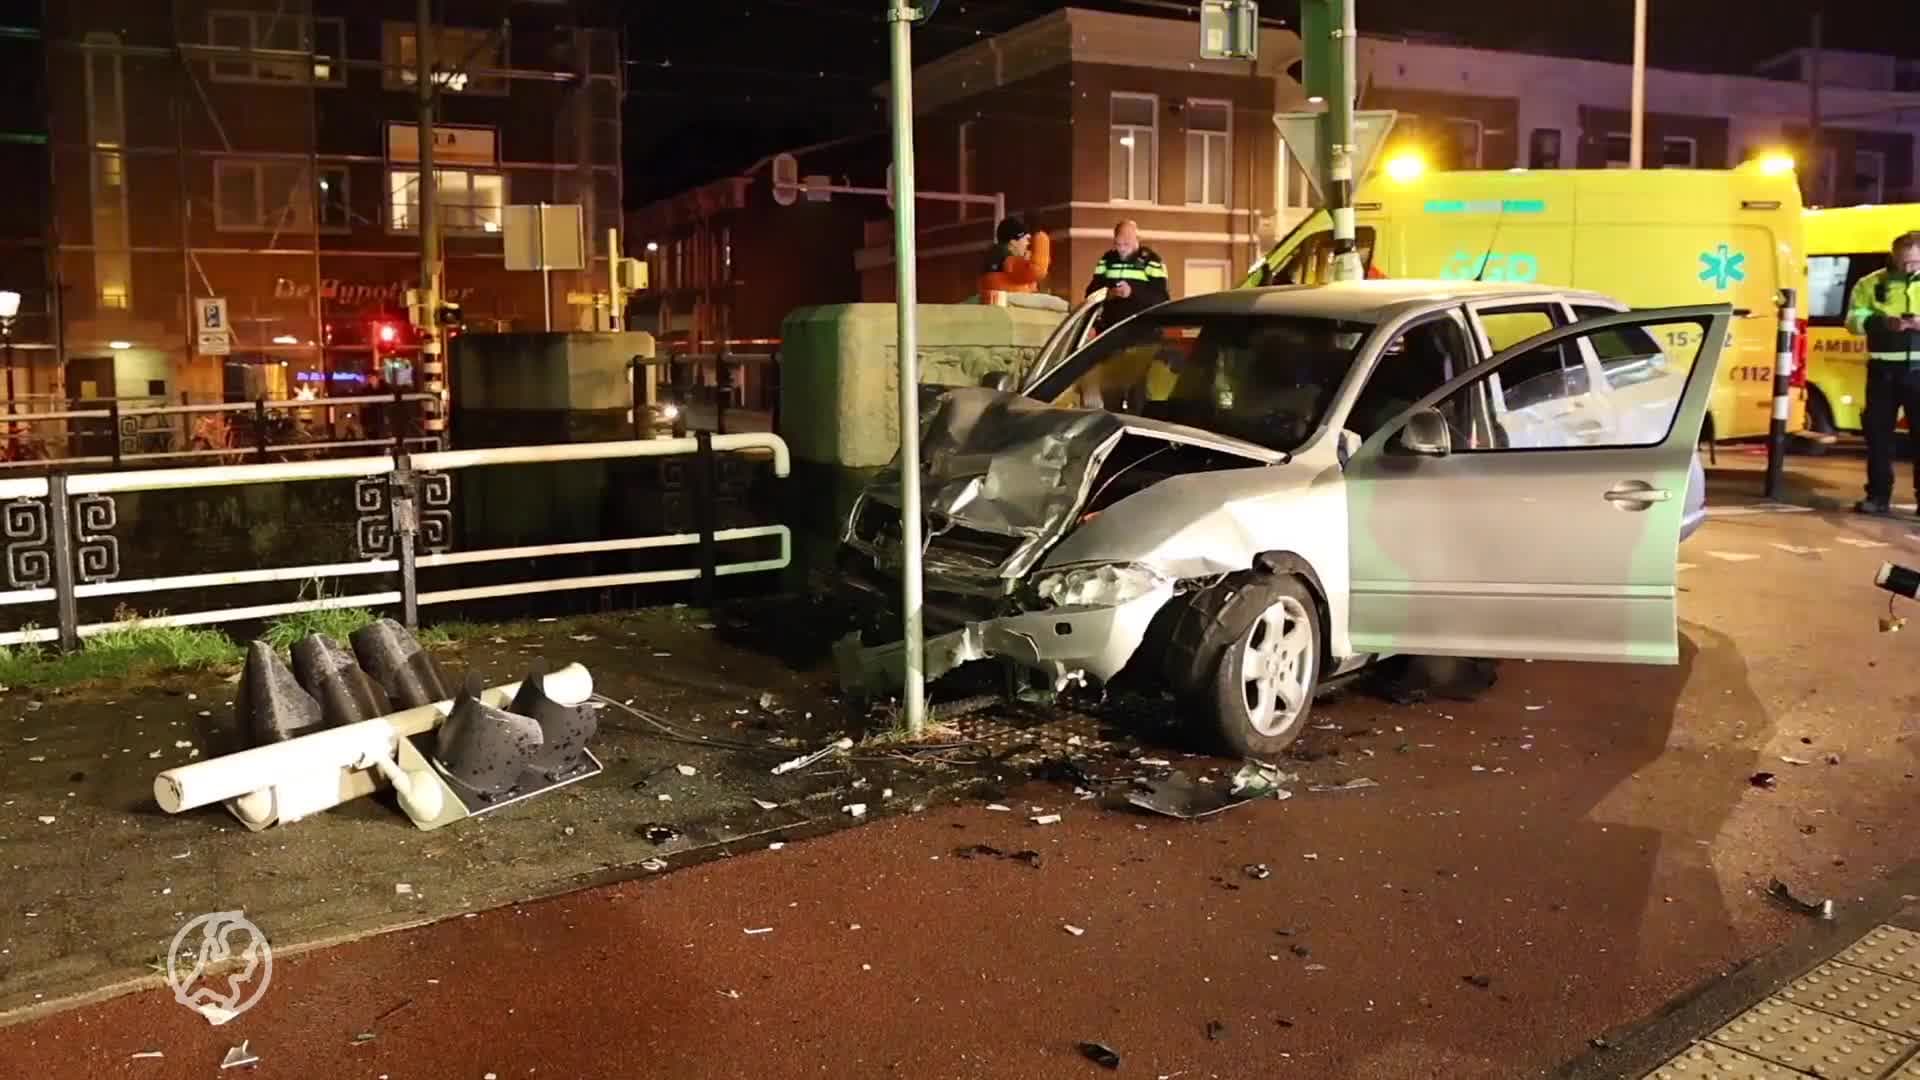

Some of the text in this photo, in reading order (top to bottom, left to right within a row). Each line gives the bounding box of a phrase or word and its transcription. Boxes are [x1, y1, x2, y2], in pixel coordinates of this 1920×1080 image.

[1440, 252, 1537, 281] GGD
[275, 277, 474, 305] De Hypoter
[1740, 366, 1771, 382] 112
